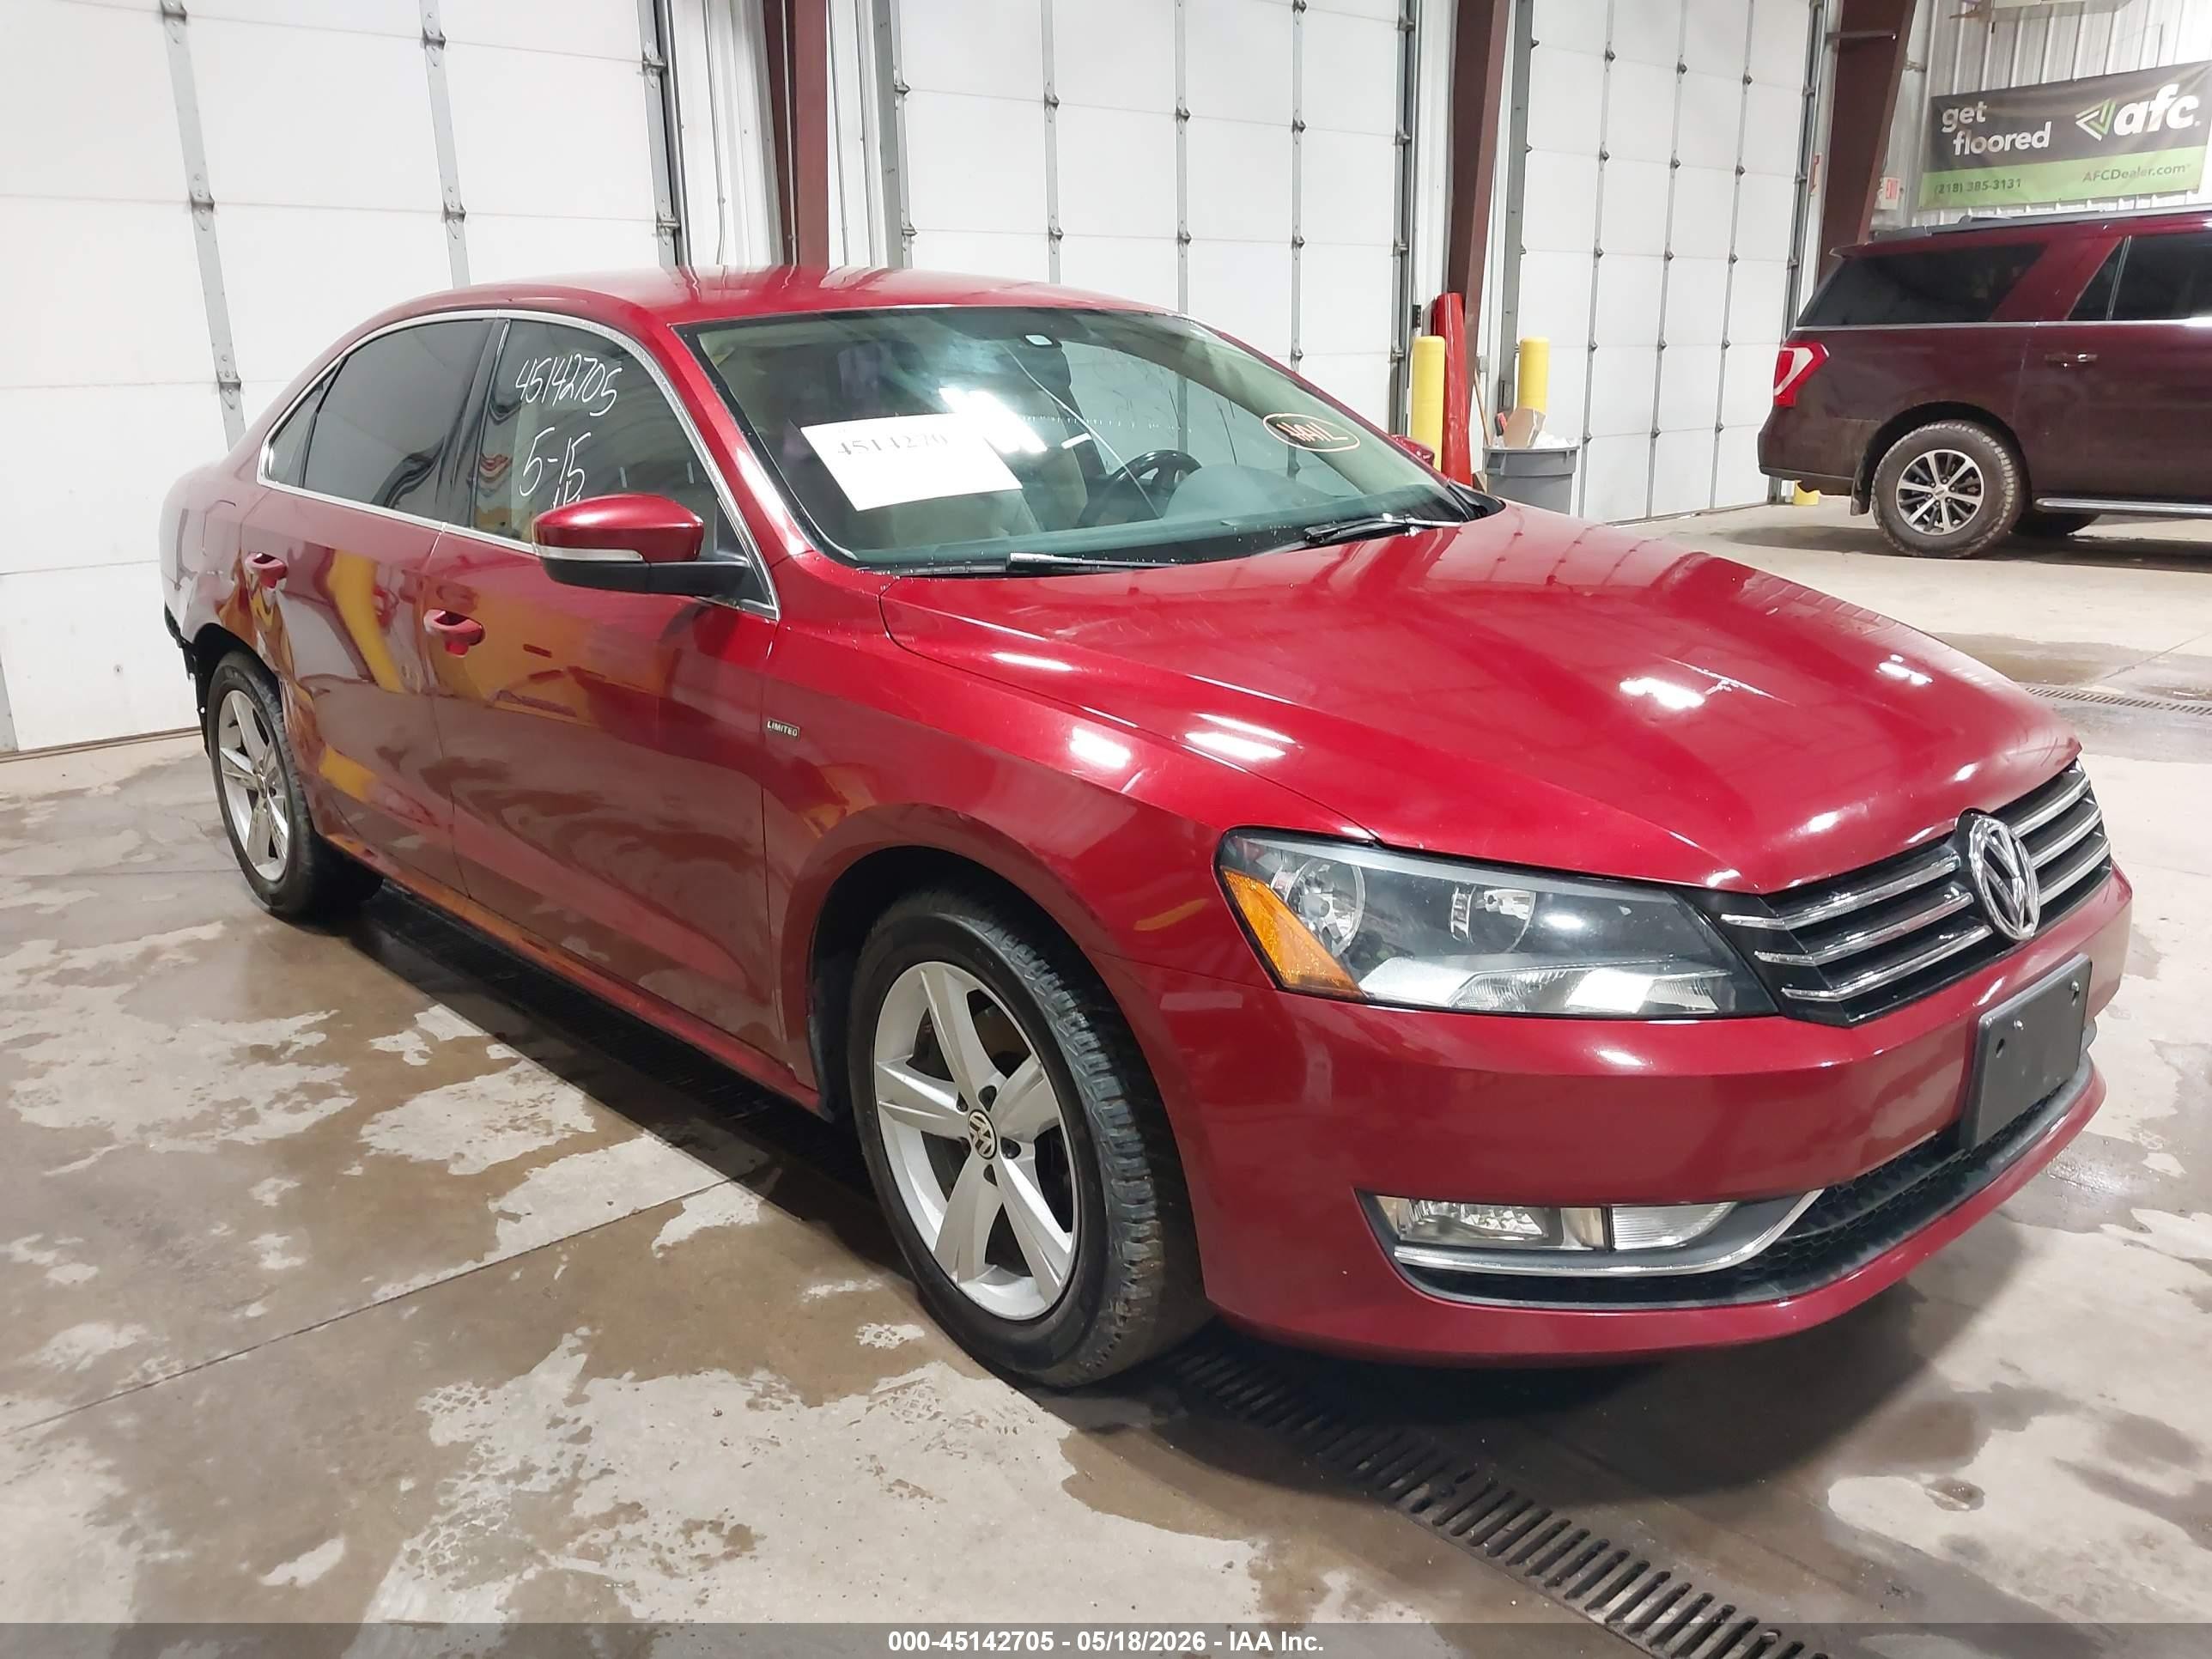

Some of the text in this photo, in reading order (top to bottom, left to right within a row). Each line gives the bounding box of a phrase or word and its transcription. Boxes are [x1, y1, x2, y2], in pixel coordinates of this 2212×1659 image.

[1942, 101, 1988, 133] get
[1953, 121, 2052, 155] floored
[1934, 183, 1964, 194] (218)
[515, 353, 623, 416] 45142705
[519, 427, 592, 496] 5-15
[767, 720, 798, 737] LIMITED
